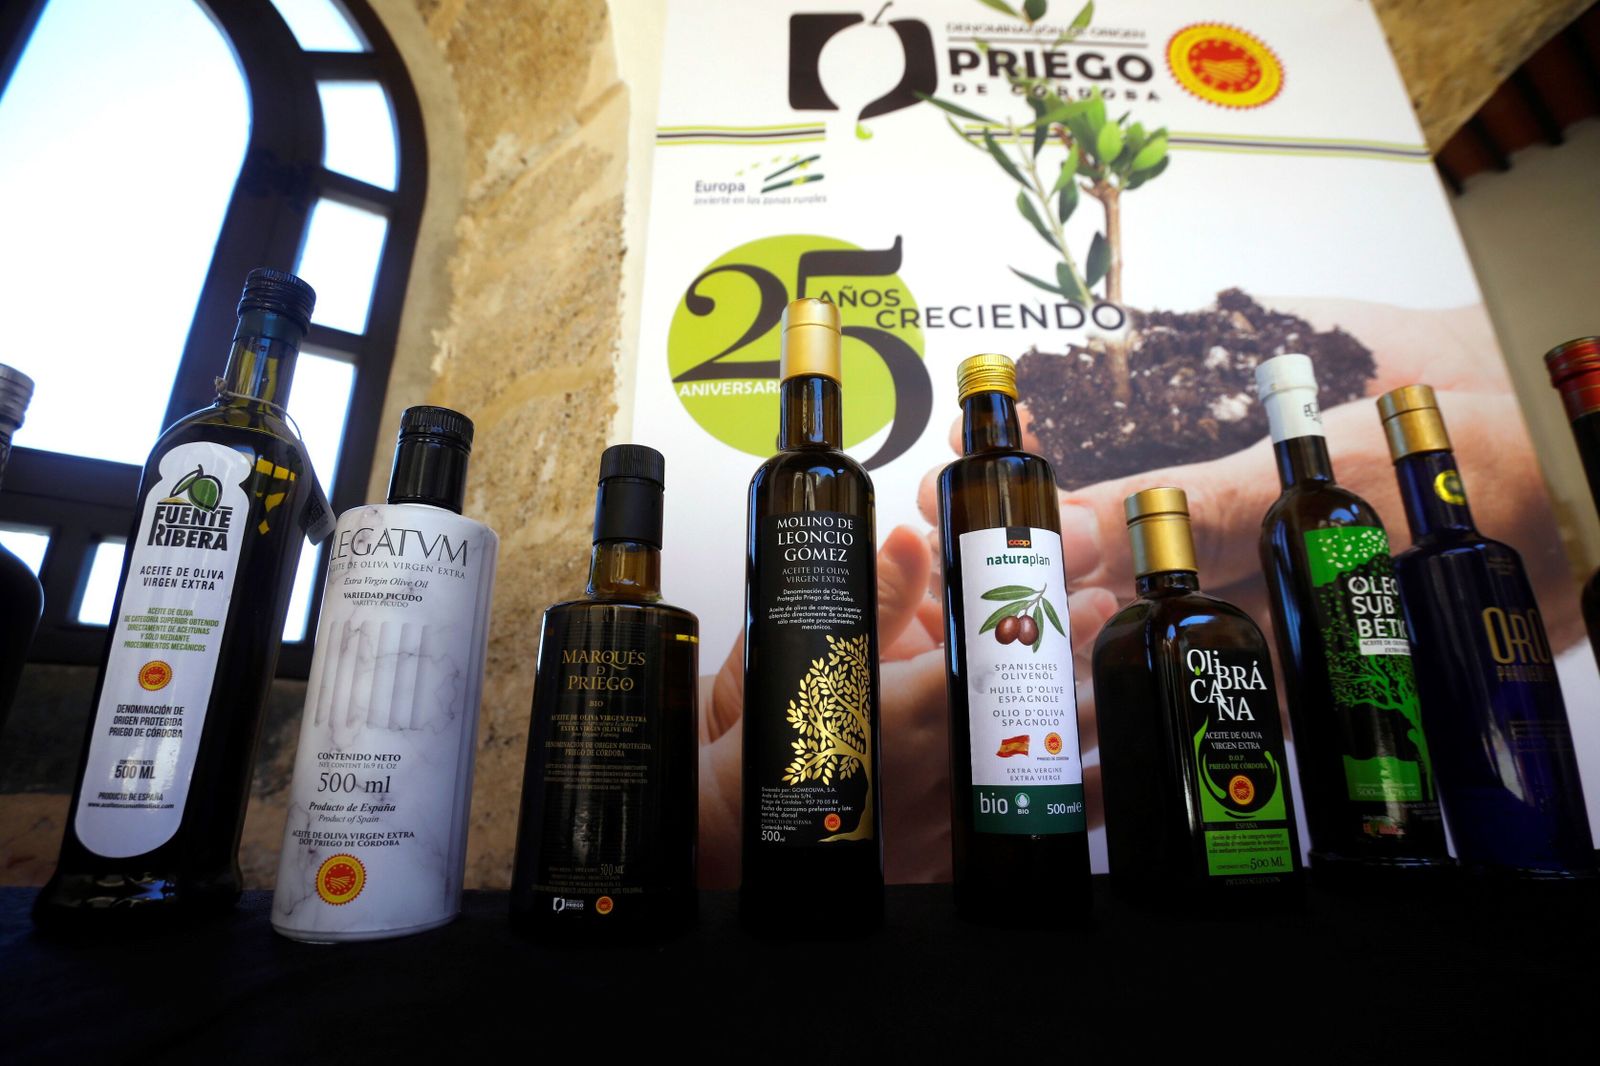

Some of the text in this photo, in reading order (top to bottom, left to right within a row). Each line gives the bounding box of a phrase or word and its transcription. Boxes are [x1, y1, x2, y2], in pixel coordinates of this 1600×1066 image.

[948, 48, 1153, 83] PRIEGO
[953, 83, 988, 96] DE
[694, 179, 746, 194] Europa
[819, 286, 901, 309] AÑOS
[875, 301, 1127, 331] CRECIENDO
[672, 235, 933, 471] 25
[152, 505, 233, 529] FUENTE
[777, 516, 854, 530] MOLINO DE
[147, 523, 228, 552] RIBERA
[777, 530, 854, 547] LEONCIO
[331, 527, 468, 568] LEGATVM
[784, 544, 848, 563] GÓMEZ
[986, 553, 1051, 566] naturaplan
[139, 566, 224, 579] ACEITE DE OLIVA
[347, 561, 357, 569] DE
[360, 560, 389, 568] OLIVA
[393, 561, 434, 572] VIRGEN
[438, 567, 465, 579] EXTRA
[782, 566, 850, 575] ACEITE DE OLIVA
[143, 577, 215, 591] VIRGEN EXTRA
[344, 576, 429, 587] Extra Virgin Olive Oil
[786, 575, 847, 584] VIRGEN EXTRA
[386, 592, 423, 602] PICUDO
[803, 594, 822, 602] Priego
[831, 588, 850, 596] Origen
[1351, 595, 1395, 616] SUB
[1481, 606, 1554, 666] ORO
[562, 649, 646, 671] MARQUÉS
[995, 663, 1058, 672] SPANISCHES
[1001, 670, 1054, 680] OLIVENÖL
[567, 675, 635, 692] PRIEGO
[990, 686, 1065, 695] HUILE D'OLIVE
[998, 695, 1060, 704] ESPAGNOLE
[116, 704, 184, 716] DENOMINACIÓN DE
[992, 709, 1065, 718] OLIO D'OLIVA
[113, 715, 183, 727] ORIGEN PROTEGIDA
[1001, 718, 1060, 727] SPAGNOLO
[109, 727, 183, 738] PRIEGO DE CÓRDOBA
[1204, 731, 1263, 740] ACEITE DE OLIVA
[1211, 741, 1261, 750] VIRGEN EXTRA
[317, 752, 401, 762] CONTENIDO NETO
[114, 765, 156, 779] 500 ML
[317, 772, 391, 795] 500 ml
[128, 792, 137, 800] DE
[308, 801, 396, 814] Producto de España
[979, 791, 1009, 815] bio
[318, 814, 379, 824] Product of Spain
[292, 829, 415, 840] ACEITE DE OLIVA VIRGEN EXTRA
[298, 837, 400, 848] DOP PRIEGO DE CÓRDOBA
[1250, 857, 1270, 871] 500
[1271, 856, 1286, 868] ML
